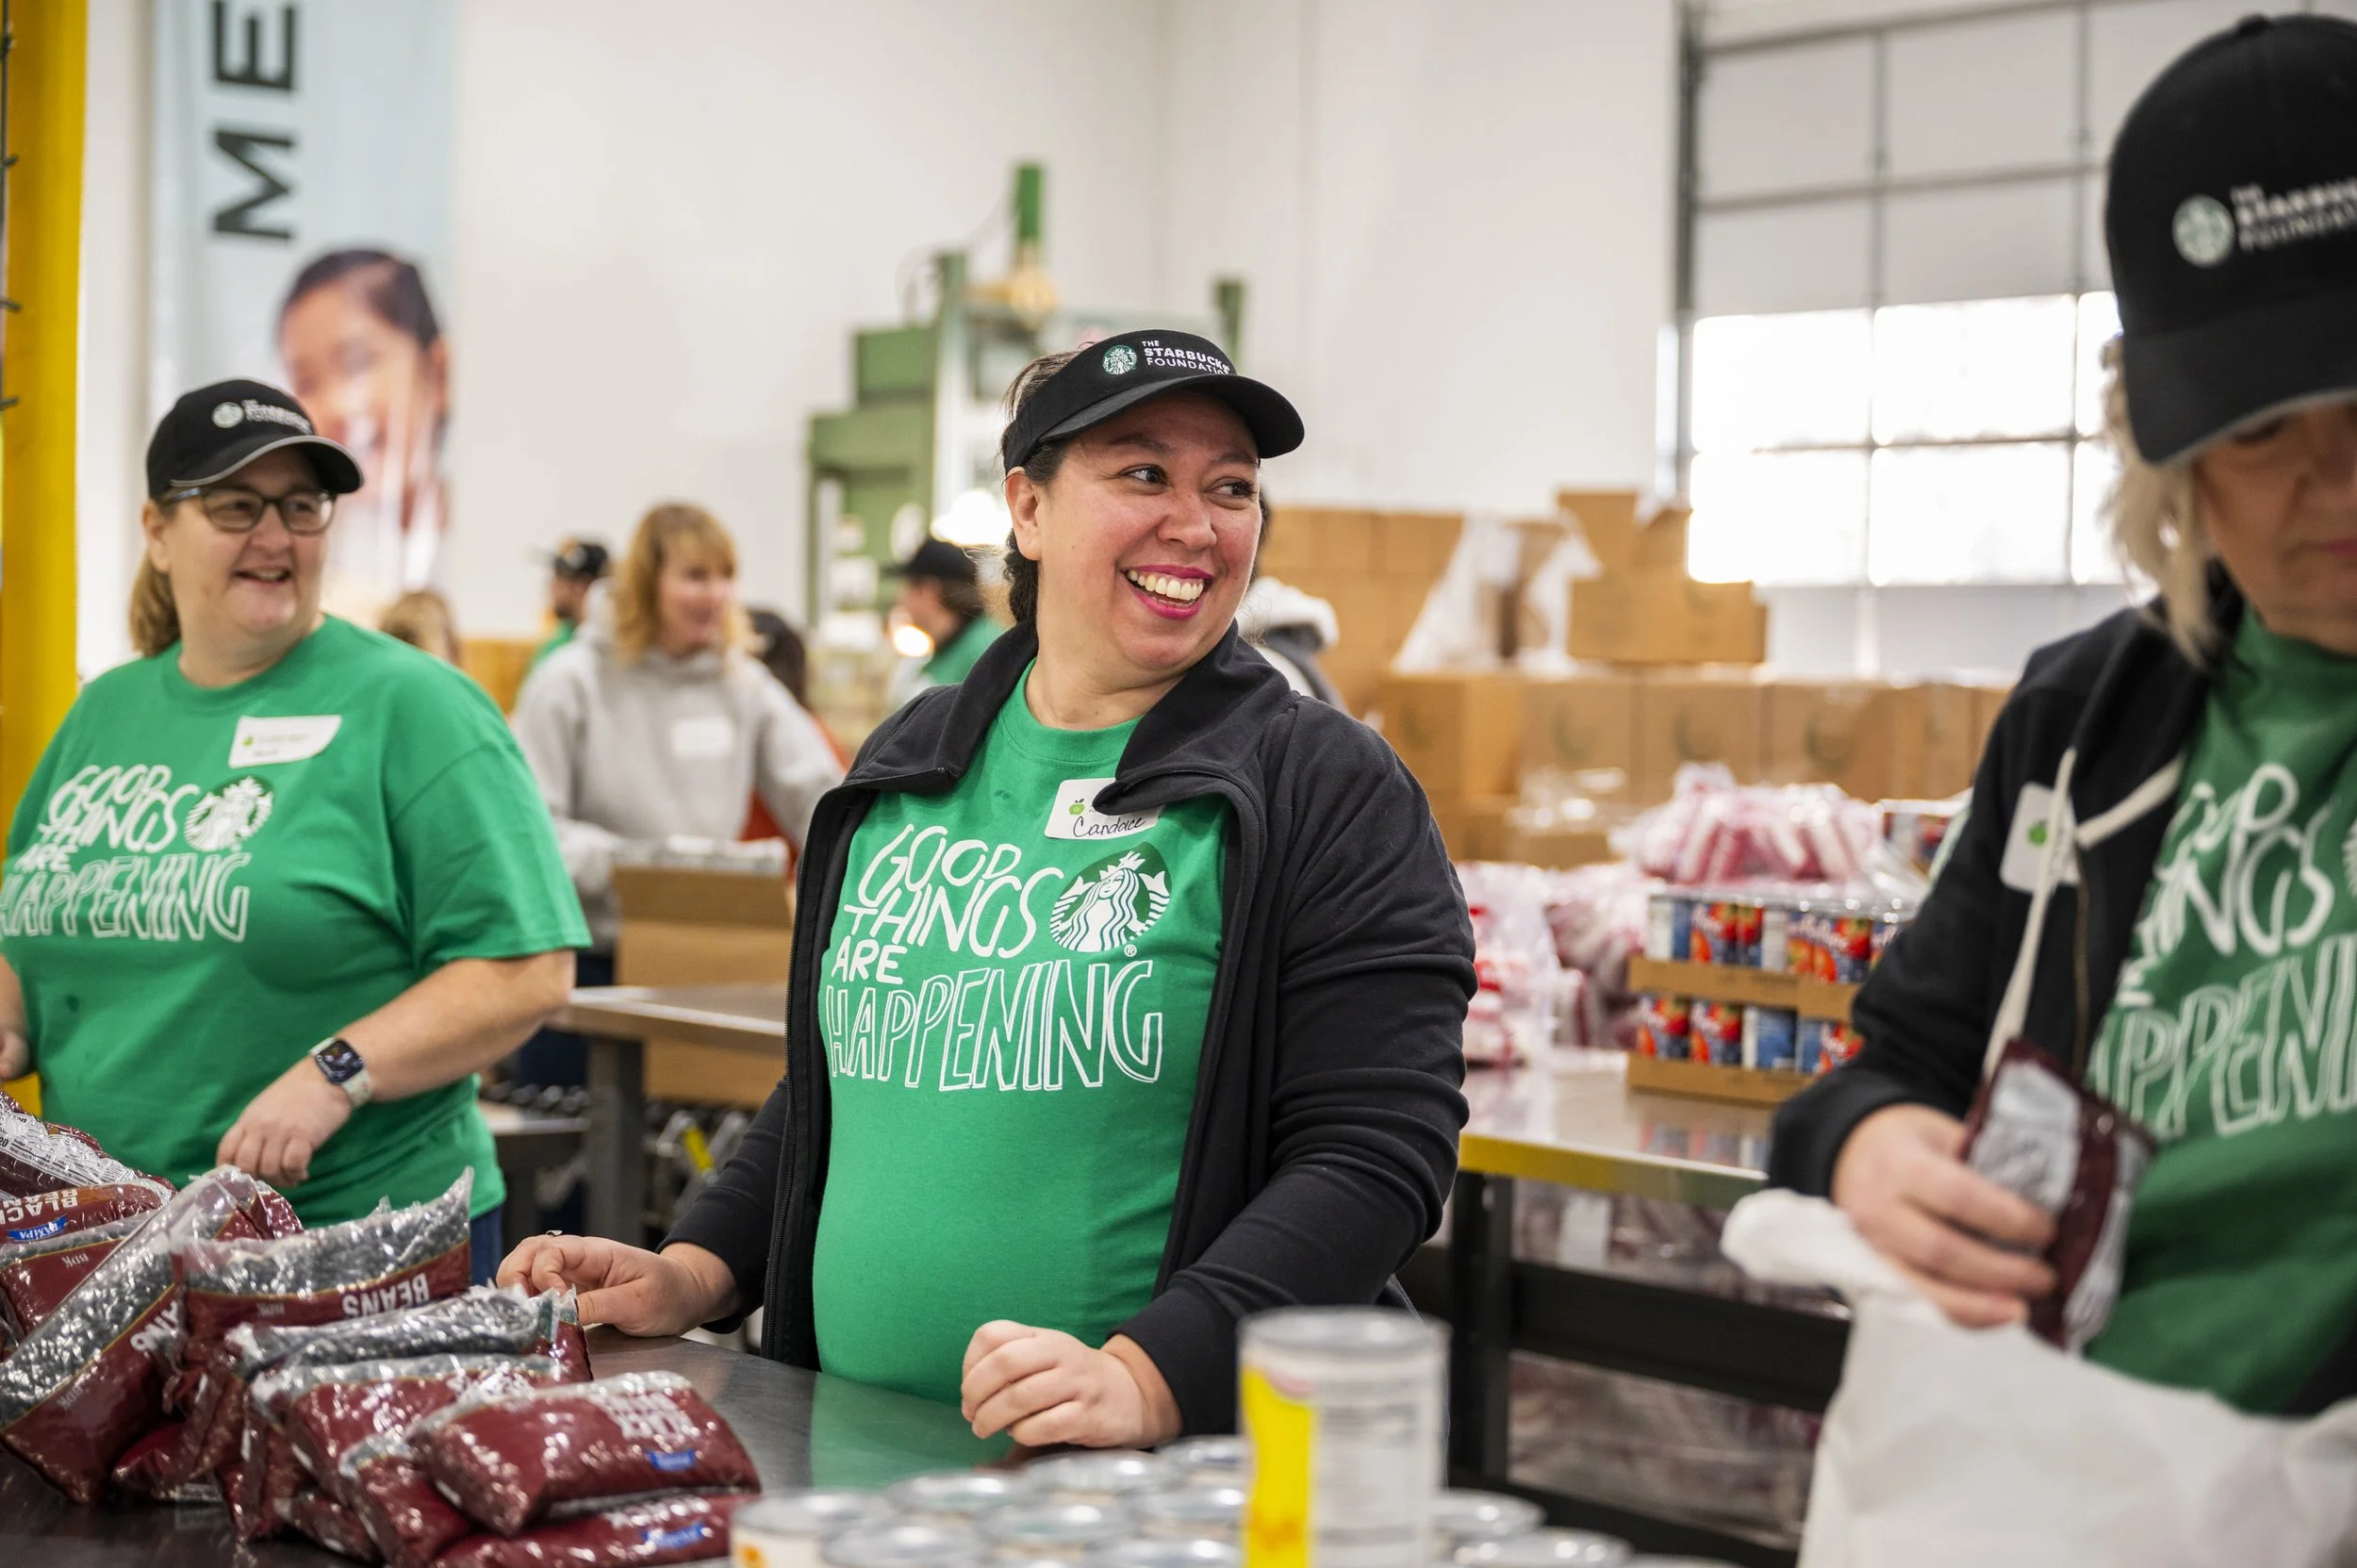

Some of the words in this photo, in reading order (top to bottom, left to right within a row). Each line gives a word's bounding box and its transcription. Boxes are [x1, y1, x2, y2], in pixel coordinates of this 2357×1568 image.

[211, 0, 294, 241] ME
[38, 784, 201, 853] THINGS
[49, 764, 172, 825] GOOD
[1073, 816, 1146, 837] Candace
[15, 843, 78, 874] ARE
[858, 823, 1022, 907] GOOD
[844, 867, 1064, 959] THINGS
[831, 935, 908, 984] ARE
[826, 959, 1163, 1092] HAPPENING
[61, 1252, 89, 1268] BDK
[342, 1273, 430, 1319] BEANS
